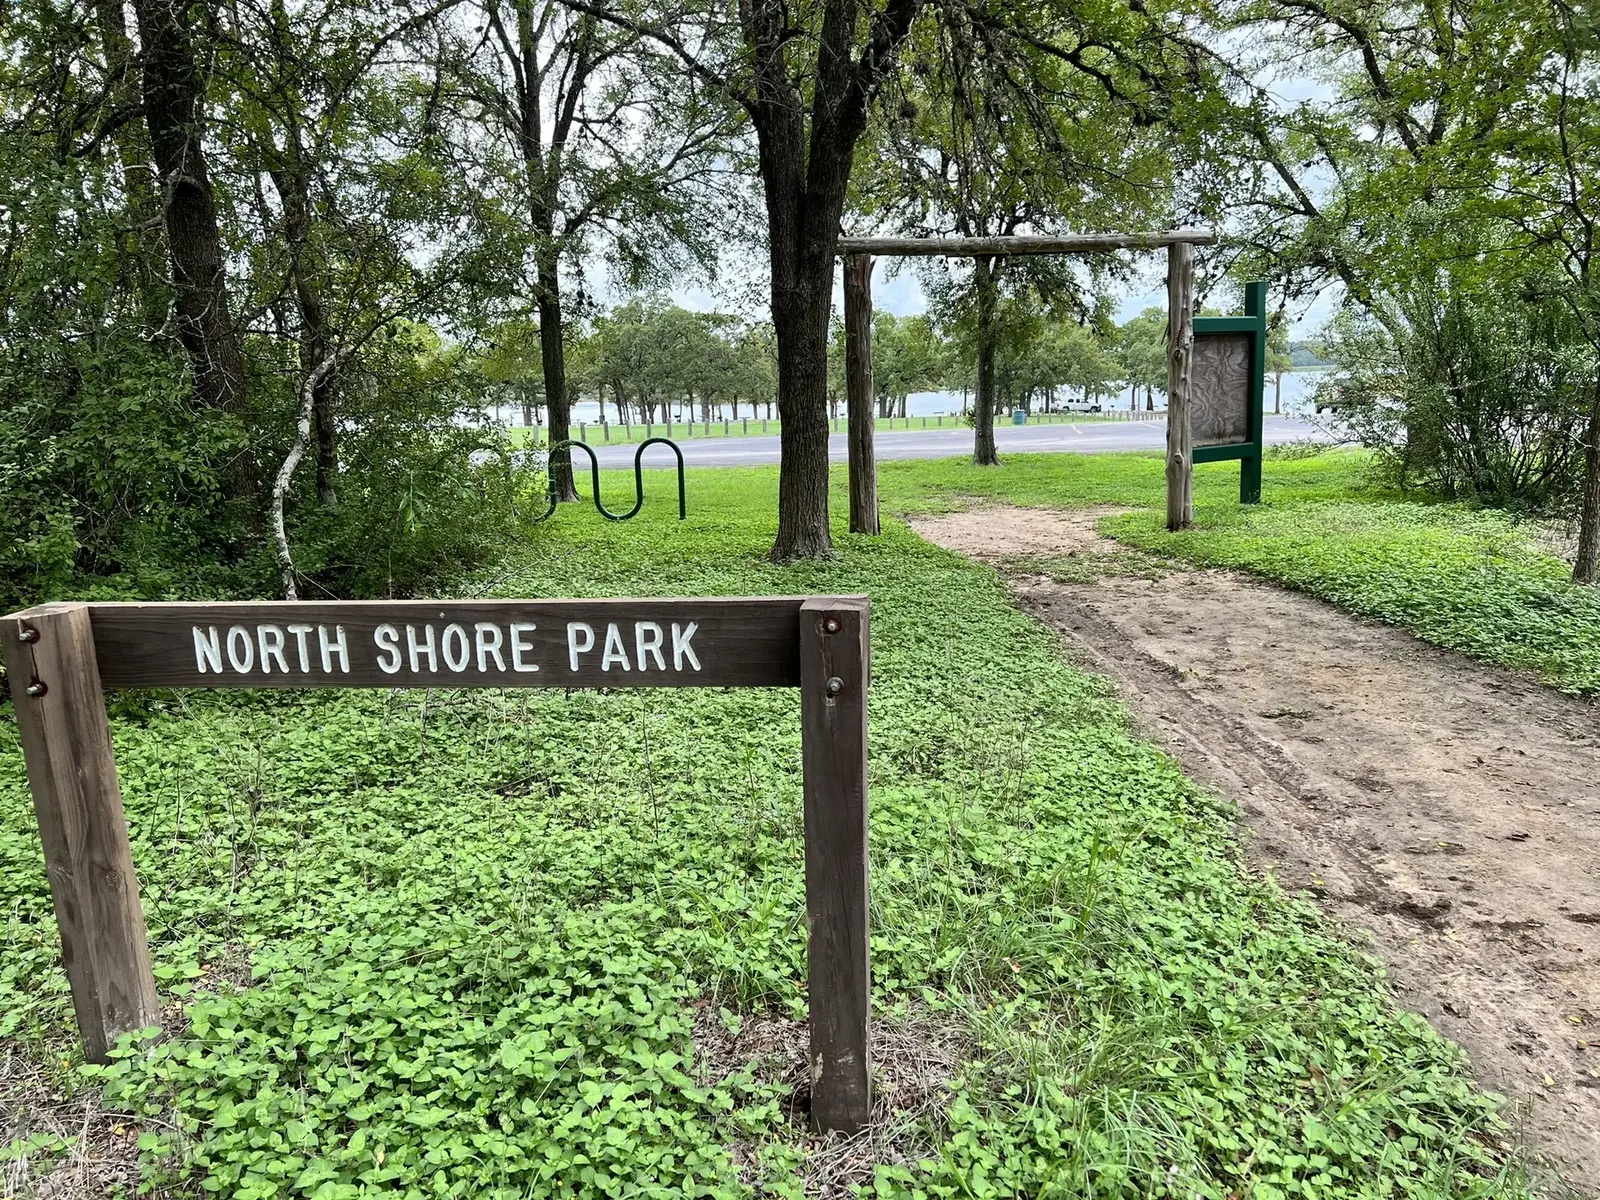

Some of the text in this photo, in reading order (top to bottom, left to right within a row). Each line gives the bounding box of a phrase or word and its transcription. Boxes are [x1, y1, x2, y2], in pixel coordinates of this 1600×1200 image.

[192, 621, 703, 675] NORTH SHORE PARK
